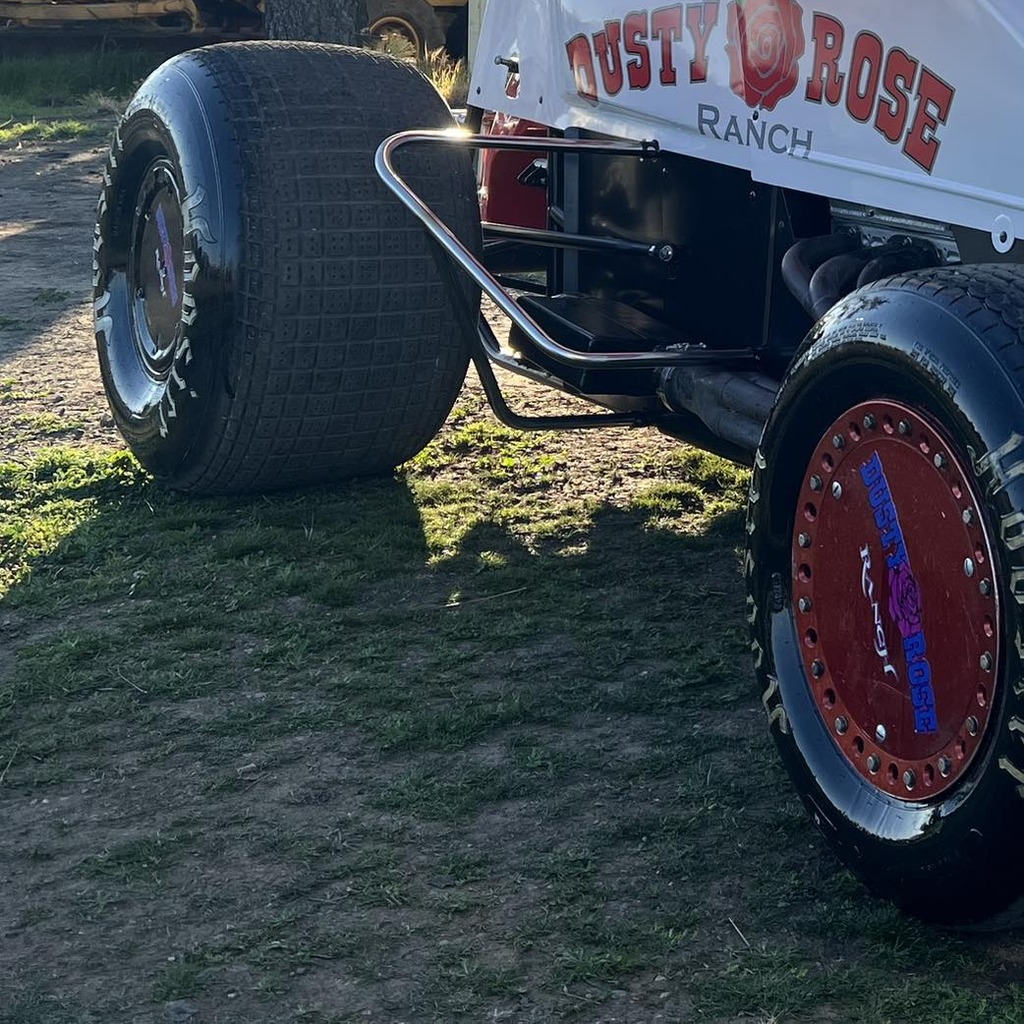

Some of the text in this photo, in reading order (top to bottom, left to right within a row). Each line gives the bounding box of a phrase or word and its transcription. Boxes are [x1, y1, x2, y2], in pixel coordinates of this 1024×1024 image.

[697, 102, 813, 159] RANCH
[805, 11, 957, 176] ROSE
[859, 450, 938, 734] DUSTY ROSE
[859, 543, 900, 682] RANCH
